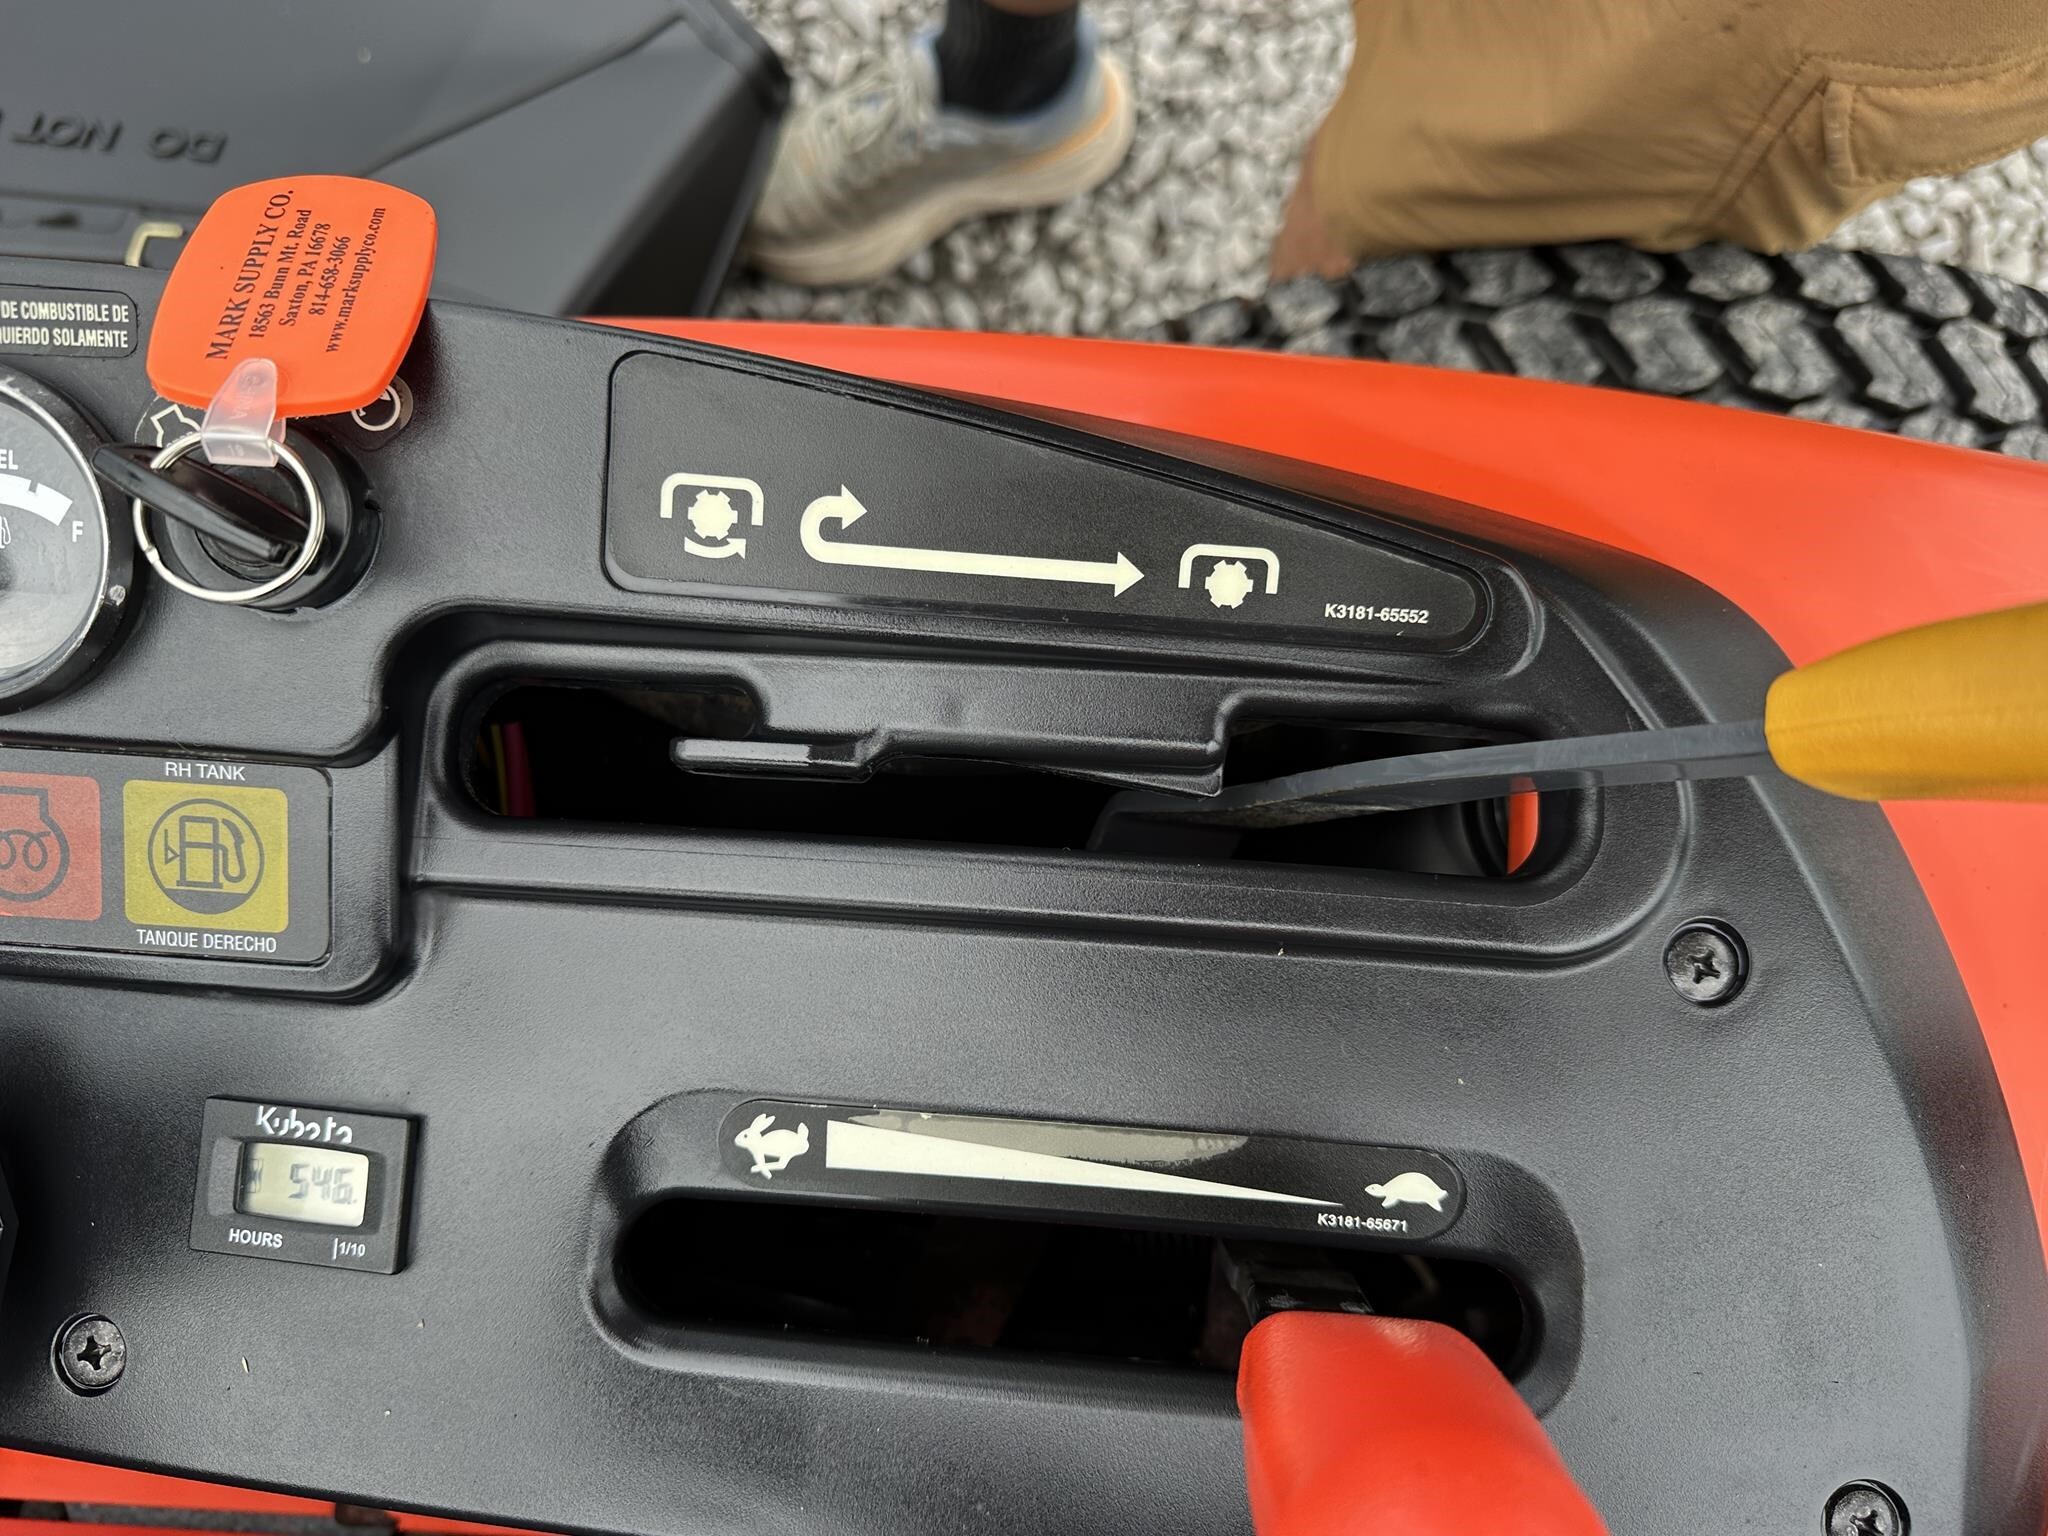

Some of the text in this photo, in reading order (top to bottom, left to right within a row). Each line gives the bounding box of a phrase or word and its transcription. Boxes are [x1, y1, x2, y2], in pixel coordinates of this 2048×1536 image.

[10, 111, 124, 153] NOT
[148, 127, 228, 164] DO
[205, 298, 251, 359] MARK
[233, 223, 280, 294] SUPPLY
[264, 190, 294, 220] CO.
[249, 209, 312, 338] 18563 Bunn Mt. Road
[278, 223, 331, 326] Saxton, PA 16678
[308, 236, 351, 316] 814-658-3066
[325, 207, 386, 352] www.marksupplyco.com
[0, 300, 129, 323] DE COMBUSTIBLE DE
[0, 326, 128, 348] UIERDO SOLAMENTE
[72, 520, 84, 543] F
[1324, 603, 1429, 624] K3181-65552
[165, 762, 246, 781] RH TANK
[136, 929, 277, 953] TANQUE DERECHO
[255, 1105, 353, 1144] Kubota
[228, 1227, 283, 1248] HOURS
[1317, 1213, 1408, 1233] K3181-65671
